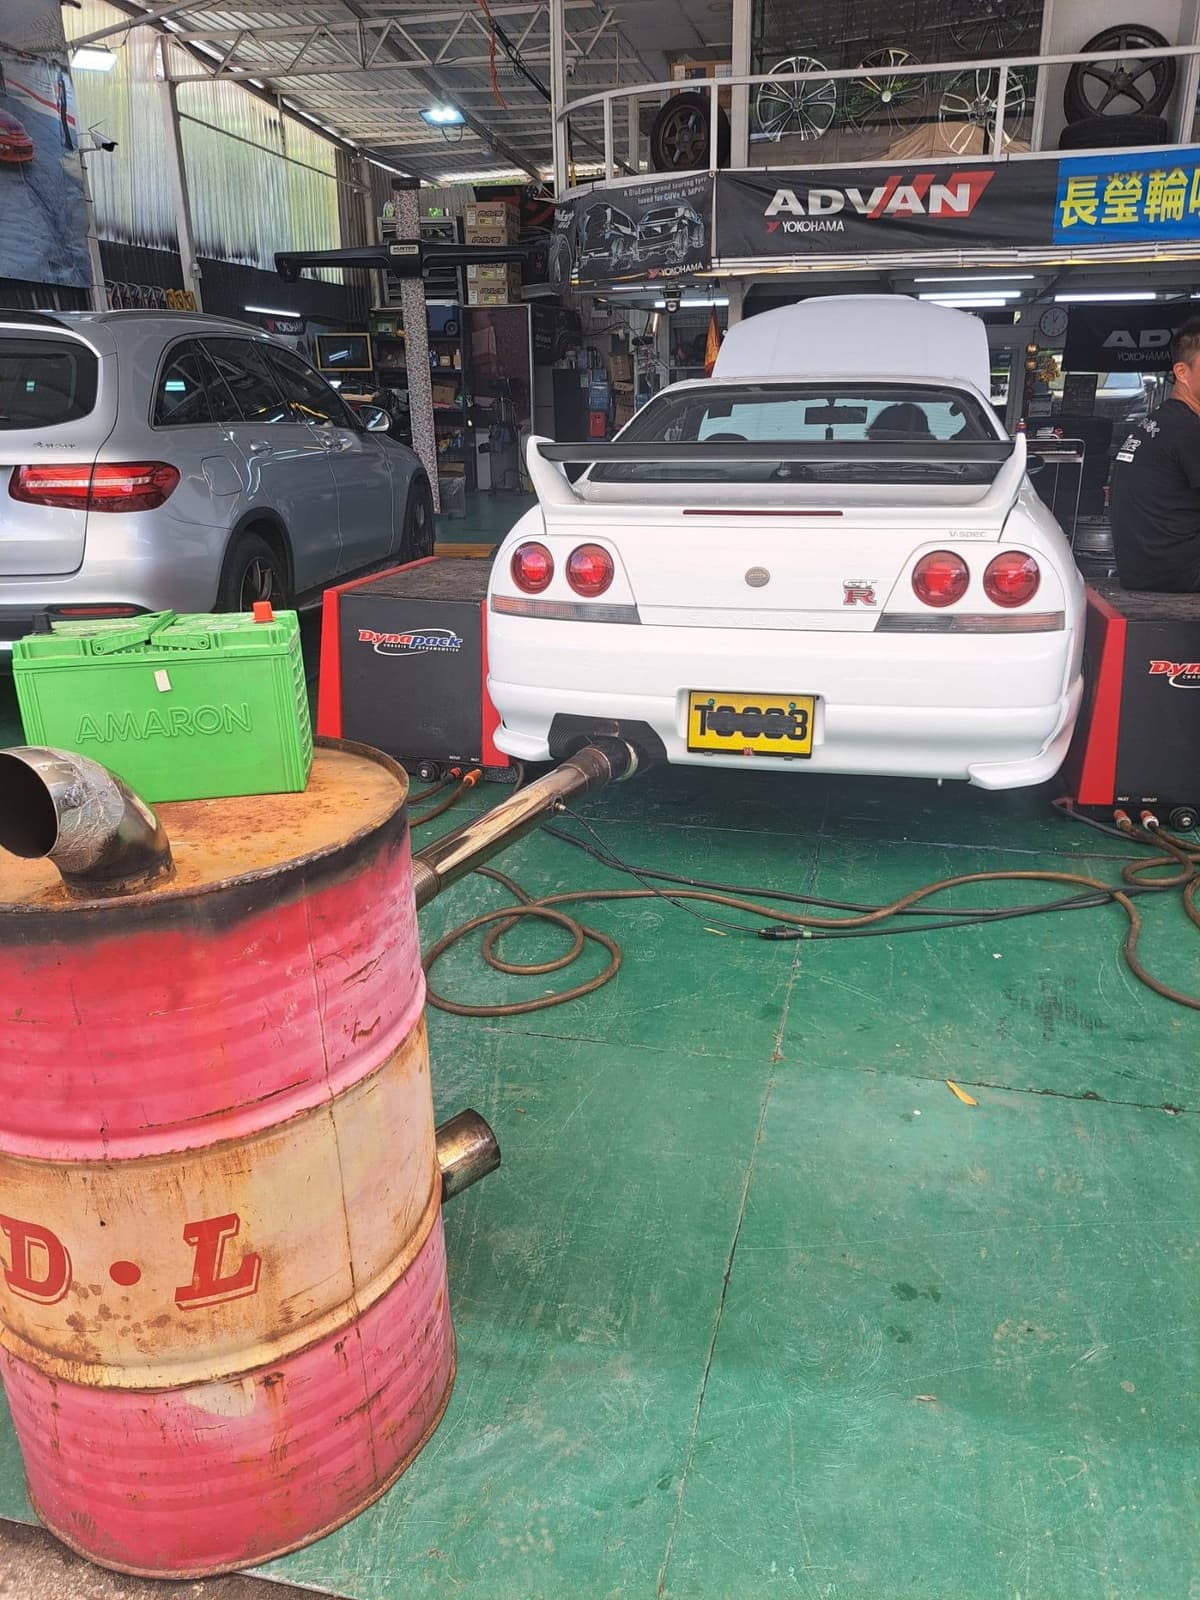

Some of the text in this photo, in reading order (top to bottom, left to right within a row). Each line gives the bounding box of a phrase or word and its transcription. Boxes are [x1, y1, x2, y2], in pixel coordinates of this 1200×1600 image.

[654, 183, 672, 194] grand
[672, 179, 694, 189] touring
[764, 174, 981, 218] ADVAN
[782, 220, 845, 233] YOKOHAMA
[660, 262, 704, 277] YOKOHAMA
[1117, 351, 1170, 362] YOKOHAMA
[358, 629, 463, 649] Dynapack
[75, 703, 252, 745] AMARON
